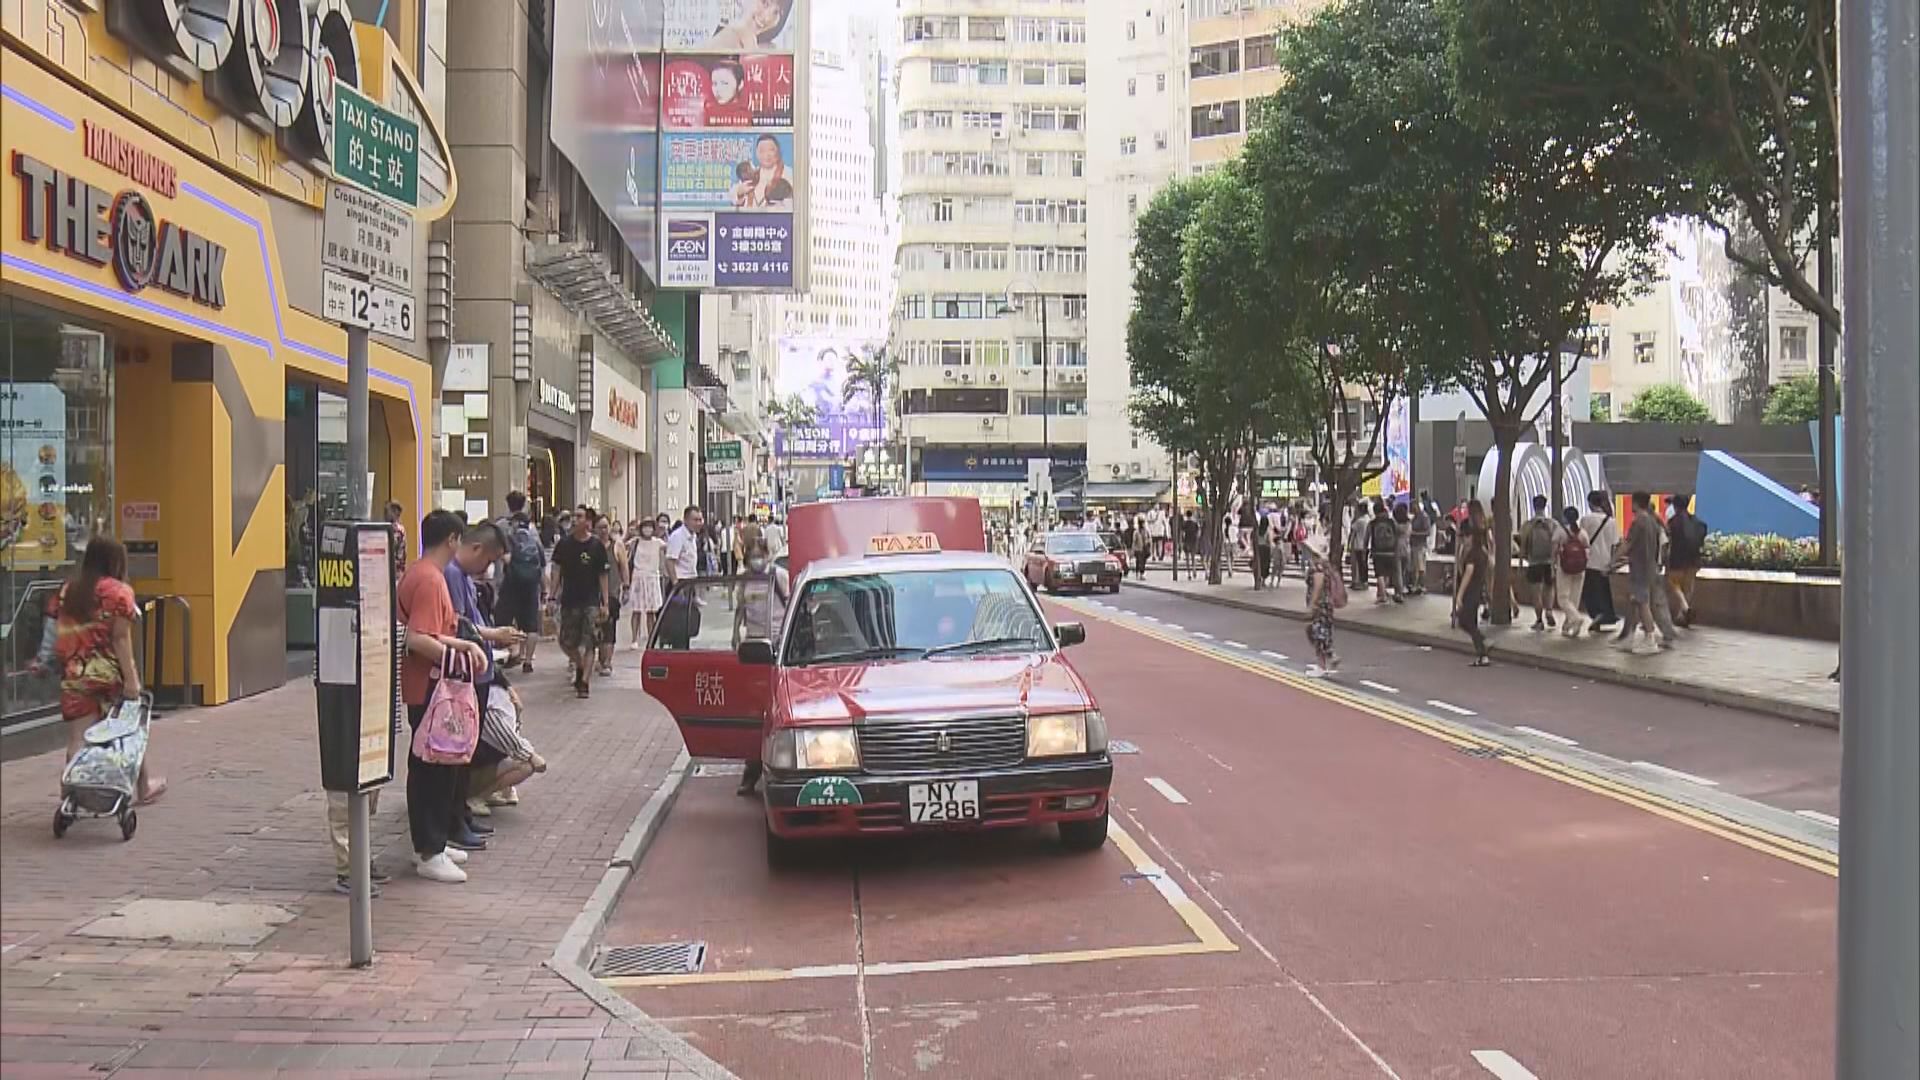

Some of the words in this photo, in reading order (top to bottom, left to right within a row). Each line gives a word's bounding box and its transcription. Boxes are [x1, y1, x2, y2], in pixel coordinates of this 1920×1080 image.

[340, 97, 368, 132] TAXI
[370, 115, 414, 154] STAND
[82, 117, 178, 200] TRANSFORMERS
[348, 133, 405, 189] 的士站
[11, 148, 114, 269] THE
[155, 218, 227, 310] ARK
[346, 207, 369, 224] single
[380, 222, 400, 238] charge
[762, 261, 789, 273] 4116
[328, 279, 347, 294] noon
[384, 297, 395, 308] am
[400, 303, 411, 332] 6
[328, 296, 346, 317] 中午
[872, 535, 932, 552] TAXI
[318, 558, 354, 588] WAIS
[695, 671, 724, 688] 的士
[696, 687, 725, 706] TAXI
[822, 785, 835, 797] 4
[927, 782, 958, 801] NY
[911, 800, 977, 822] 7286
